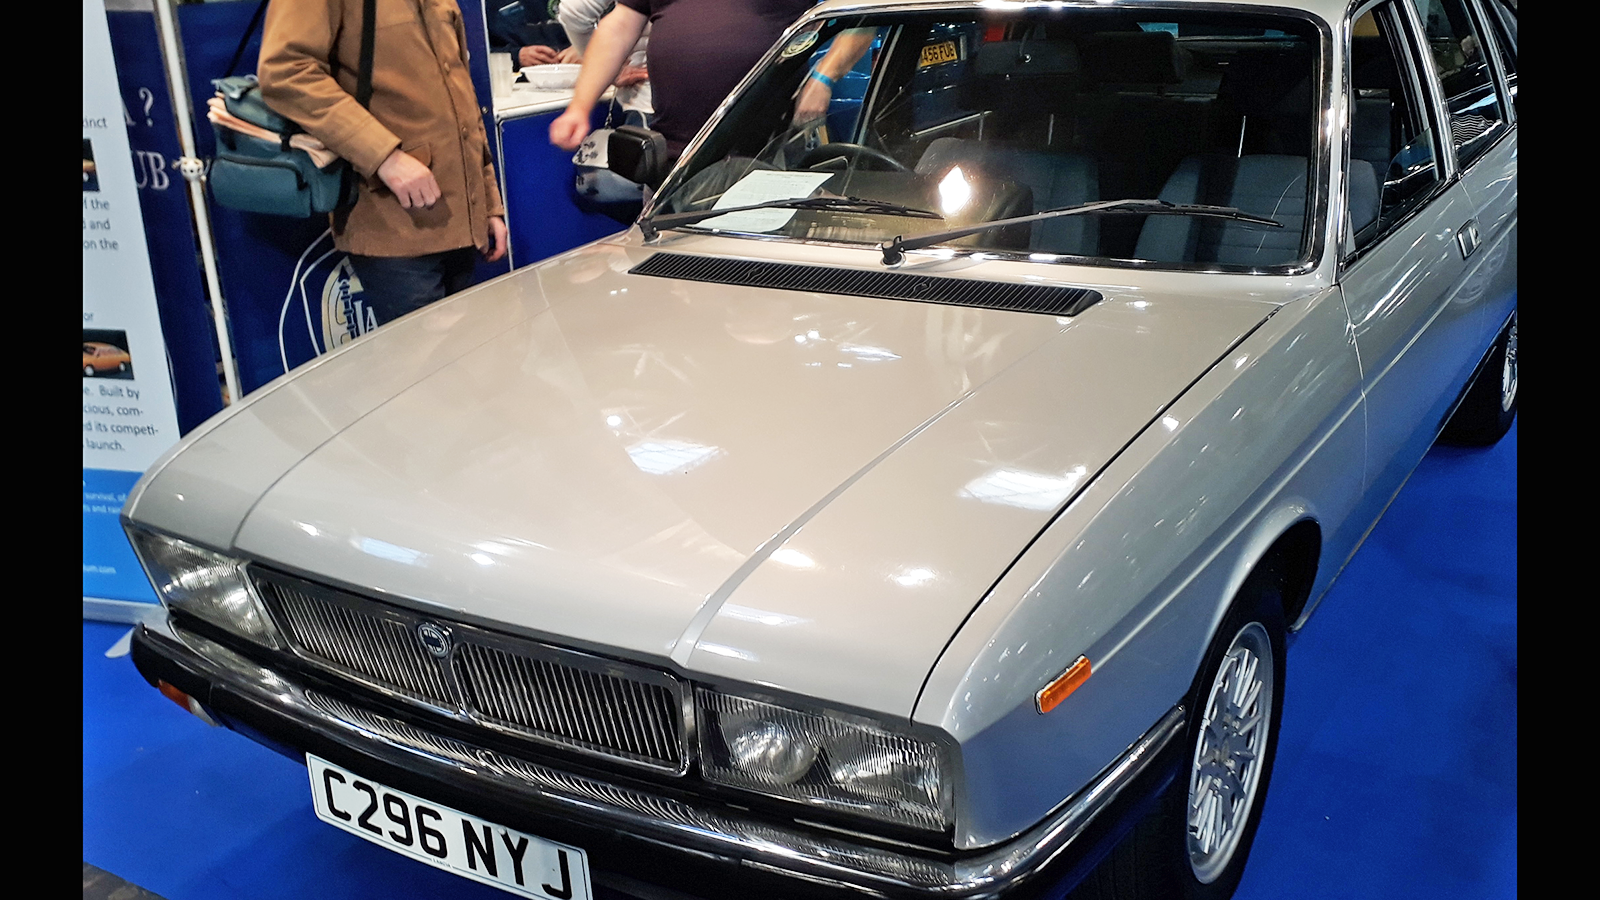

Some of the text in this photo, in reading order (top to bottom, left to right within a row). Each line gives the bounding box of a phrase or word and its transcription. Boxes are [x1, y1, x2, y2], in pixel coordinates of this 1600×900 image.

[90, 198, 110, 210] the
[90, 218, 111, 230] and
[99, 237, 119, 251] the
[99, 385, 124, 397] Built
[126, 386, 140, 401] by
[94, 421, 108, 432] its
[322, 768, 573, 900] C296 NYJ
